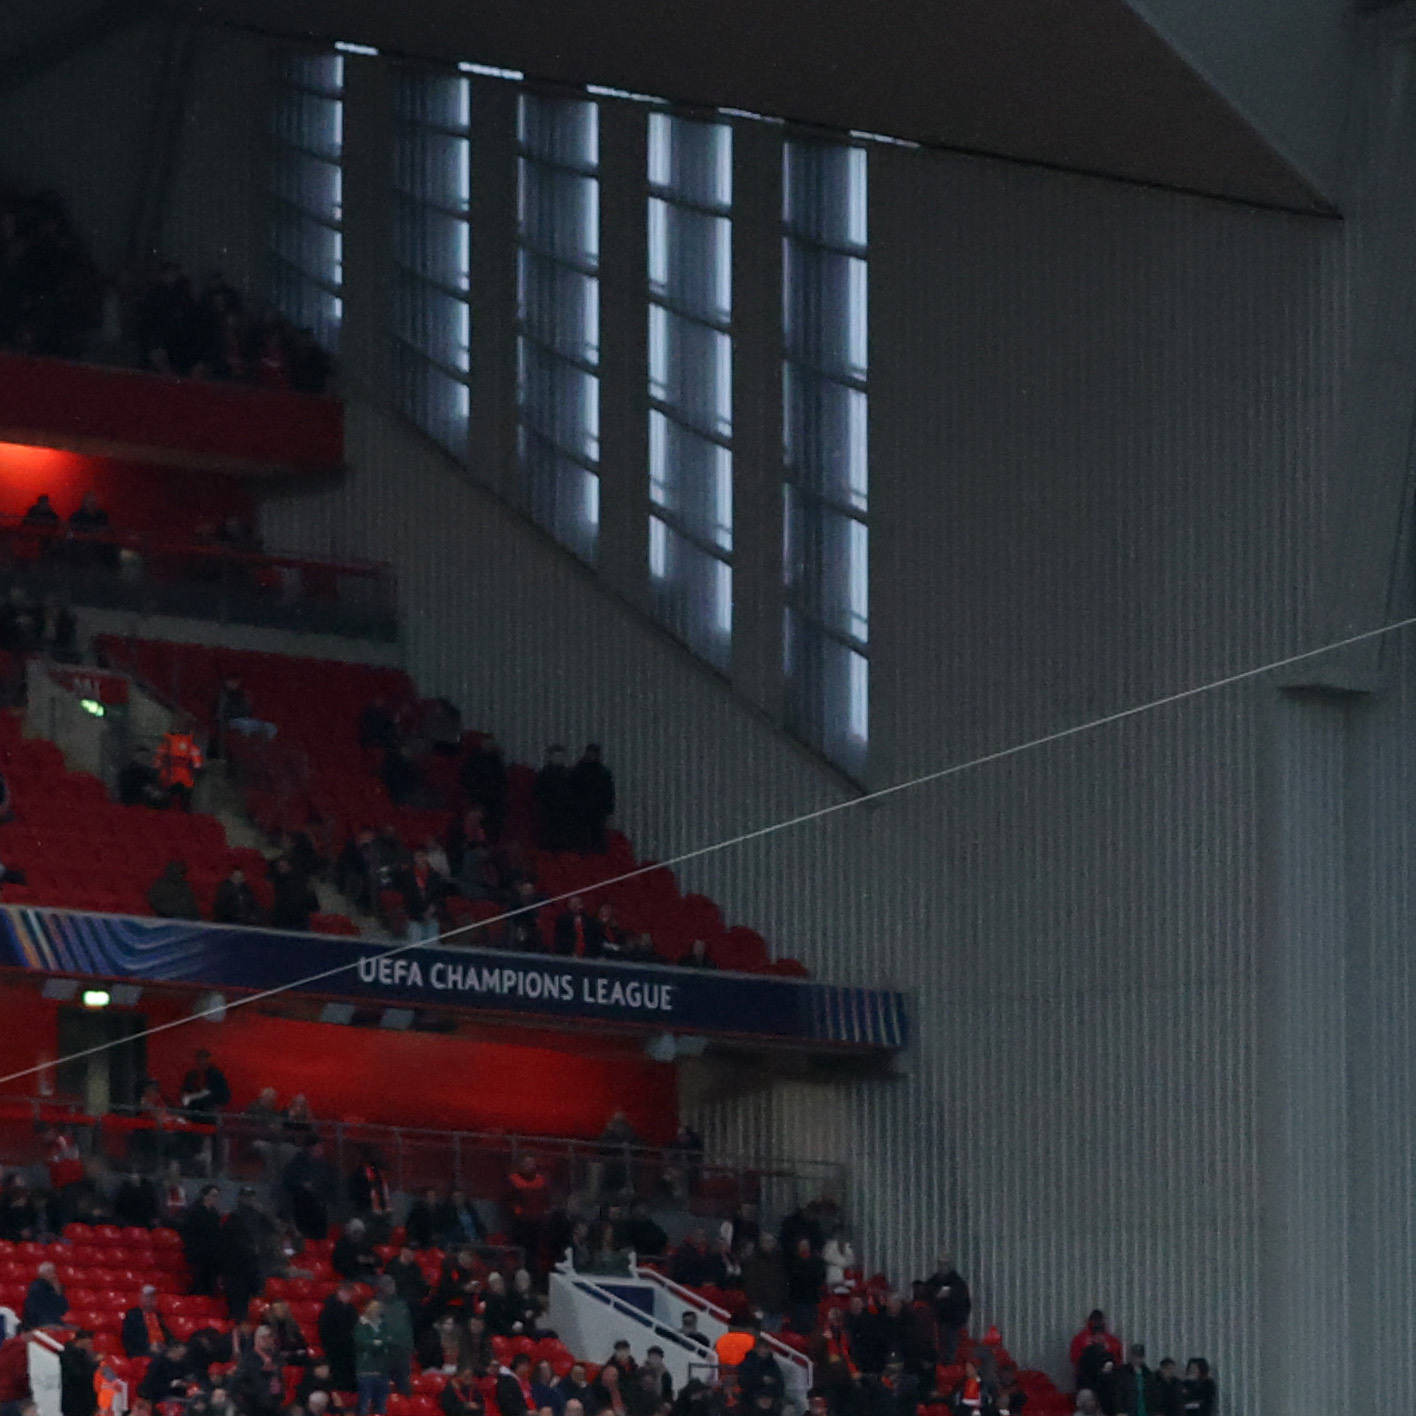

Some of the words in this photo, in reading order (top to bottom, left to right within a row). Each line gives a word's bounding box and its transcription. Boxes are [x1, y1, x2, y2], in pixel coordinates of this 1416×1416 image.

[359, 957, 424, 987] UEFA
[430, 962, 575, 1000] CHAMPIONS
[583, 978, 672, 1010] LEAGUE
